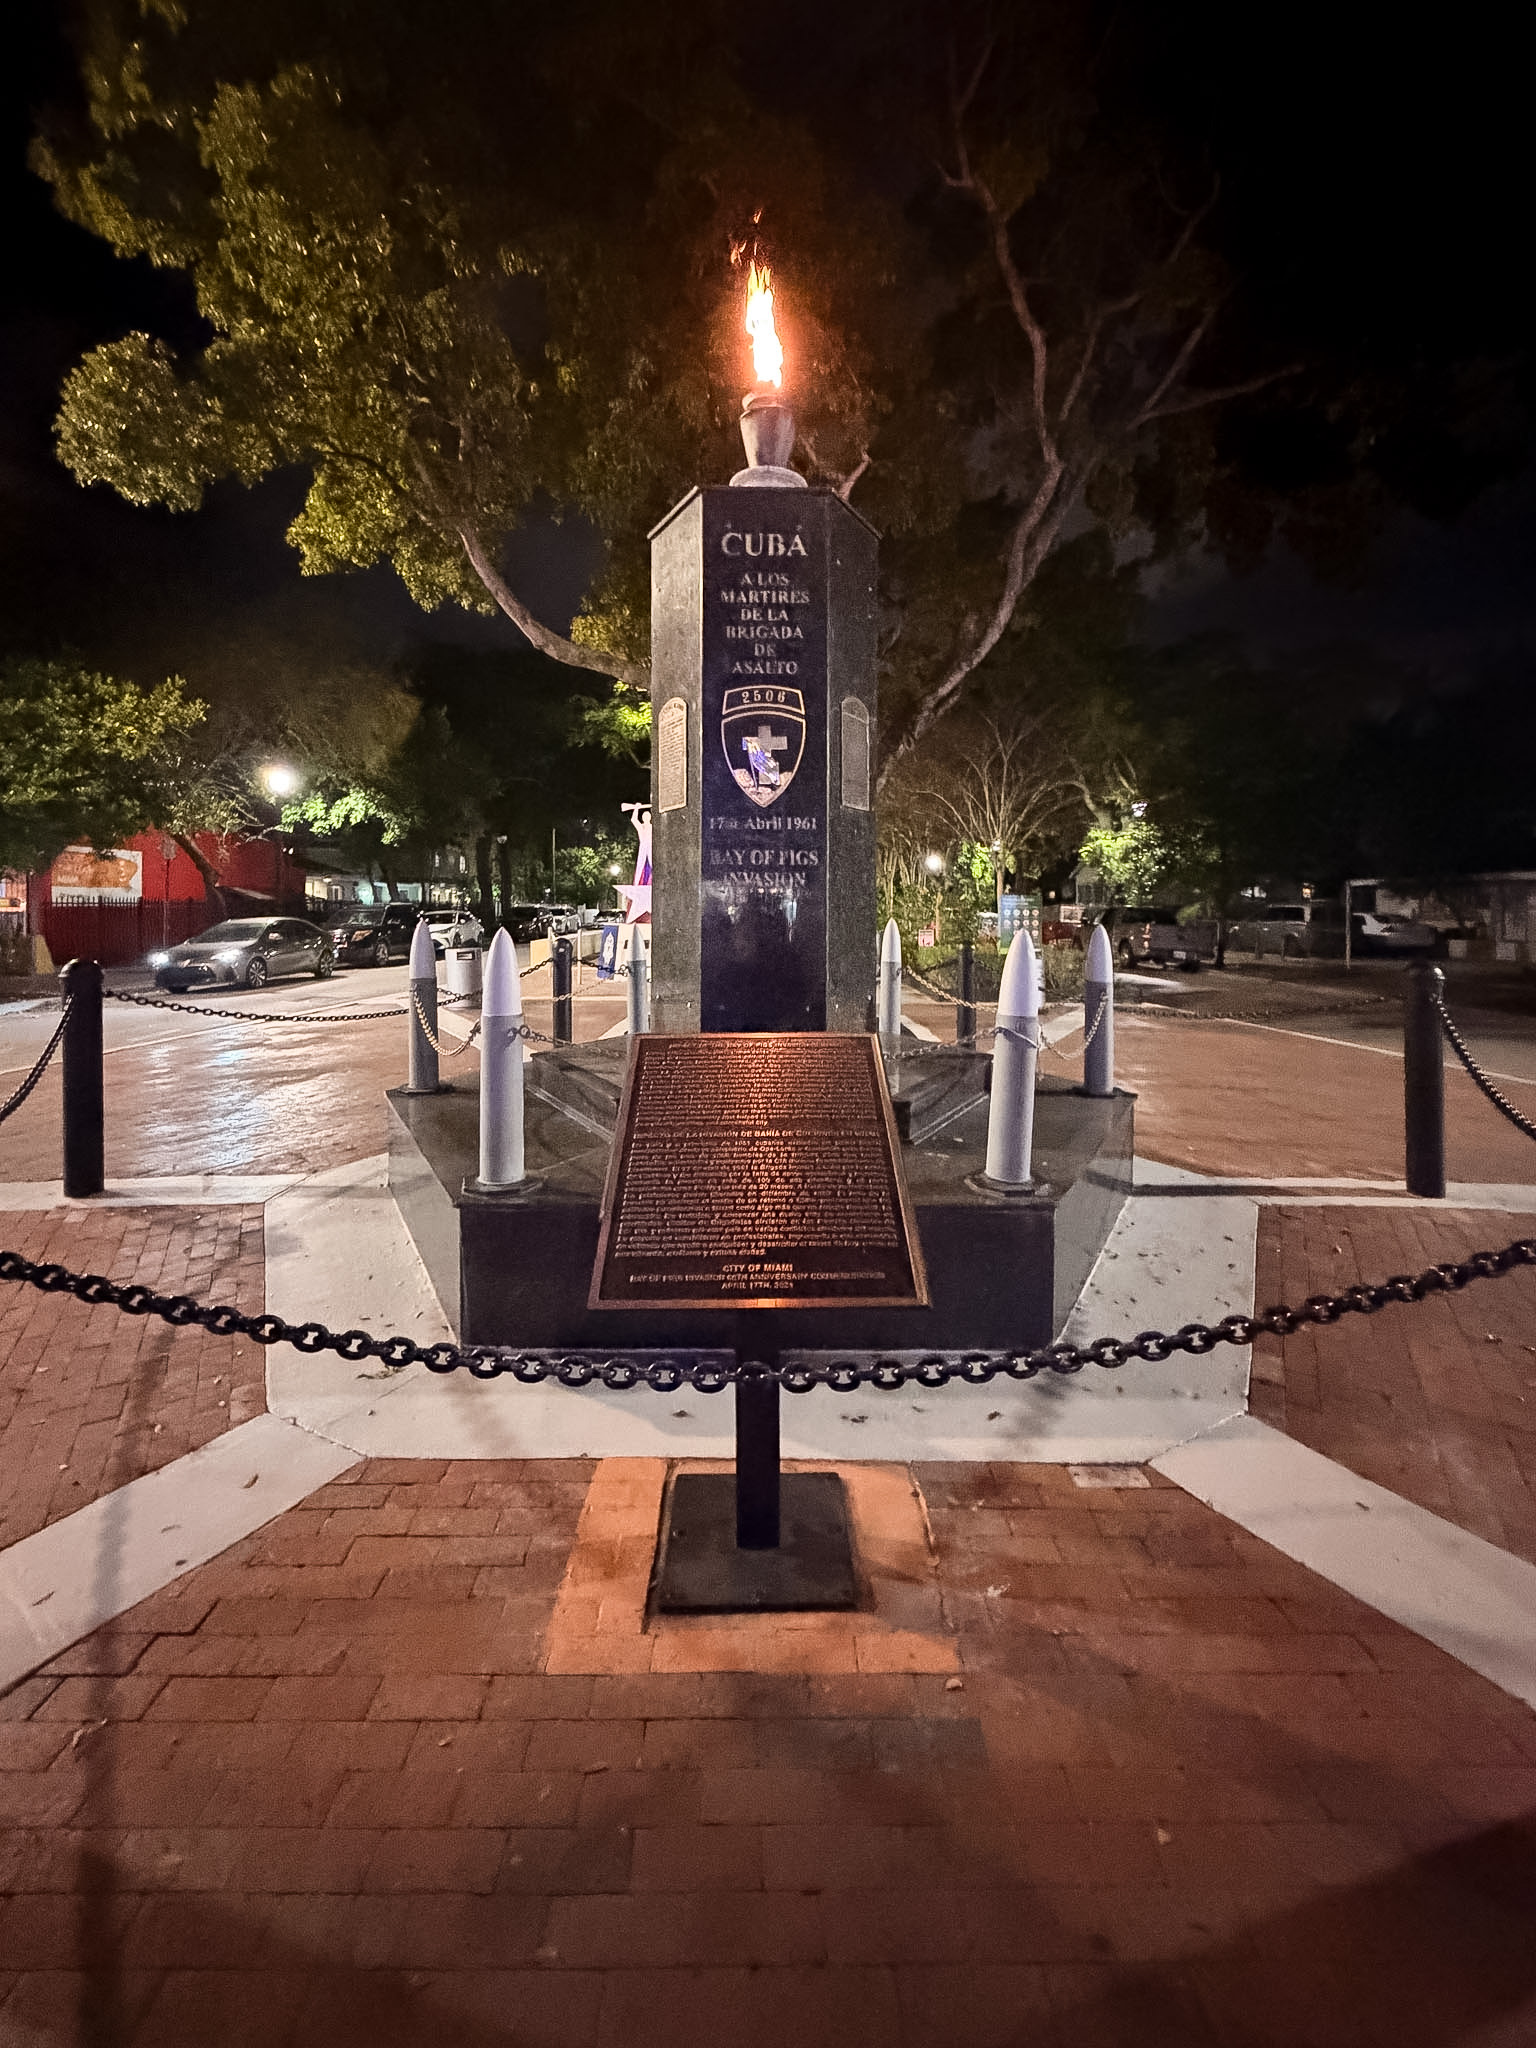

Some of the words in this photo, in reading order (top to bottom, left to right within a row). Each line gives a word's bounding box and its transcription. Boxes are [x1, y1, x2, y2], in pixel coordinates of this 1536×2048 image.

[721, 532, 808, 557] CUBA
[740, 573, 752, 586] A
[757, 573, 790, 587] LOS
[720, 590, 810, 604] MARTIRES
[741, 608, 763, 621] DE
[767, 608, 789, 621] LA
[725, 625, 804, 639] BRIGADA
[754, 643, 776, 657] DE
[732, 661, 798, 675] ASALTO
[741, 690, 786, 704] 2506
[745, 816, 782, 830] Abril
[787, 816, 817, 830] 1961
[710, 849, 745, 866] BAY
[750, 849, 774, 866] OF
[779, 849, 819, 866] PIGS
[723, 1264, 745, 1272] CITY
[748, 1264, 760, 1272] OF
[763, 1264, 793, 1272] MIAMI
